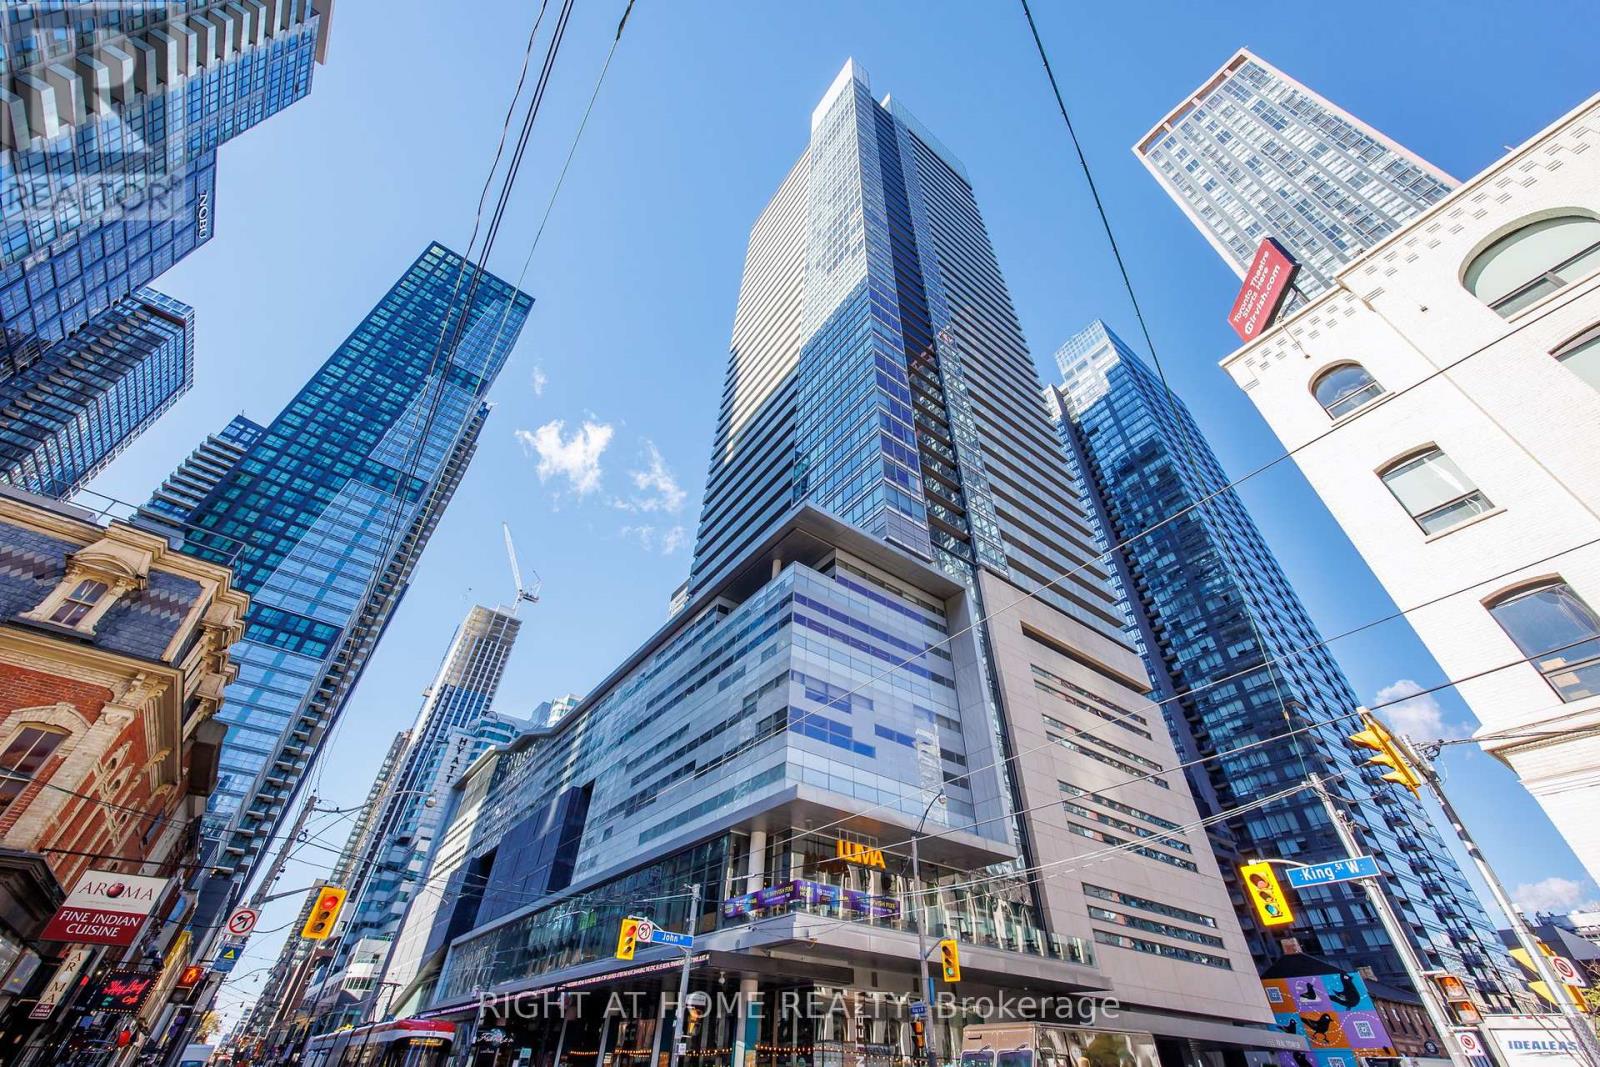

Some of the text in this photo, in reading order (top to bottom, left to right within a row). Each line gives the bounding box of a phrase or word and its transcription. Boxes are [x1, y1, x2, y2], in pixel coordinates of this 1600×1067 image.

[199, 191, 208, 239] NOBU
[1234, 250, 1269, 322] Toronto Theatre
[446, 737, 468, 783] HYATT
[836, 839, 886, 869] LUMA
[1302, 866, 1335, 880] King
[1345, 860, 1360, 874] W
[78, 881, 154, 900] AROMA
[59, 910, 140, 927] FINE INDIAN
[66, 923, 120, 937] CUISINE
[662, 931, 678, 943] John
[1508, 1040, 1577, 1050] IDEALEAS
